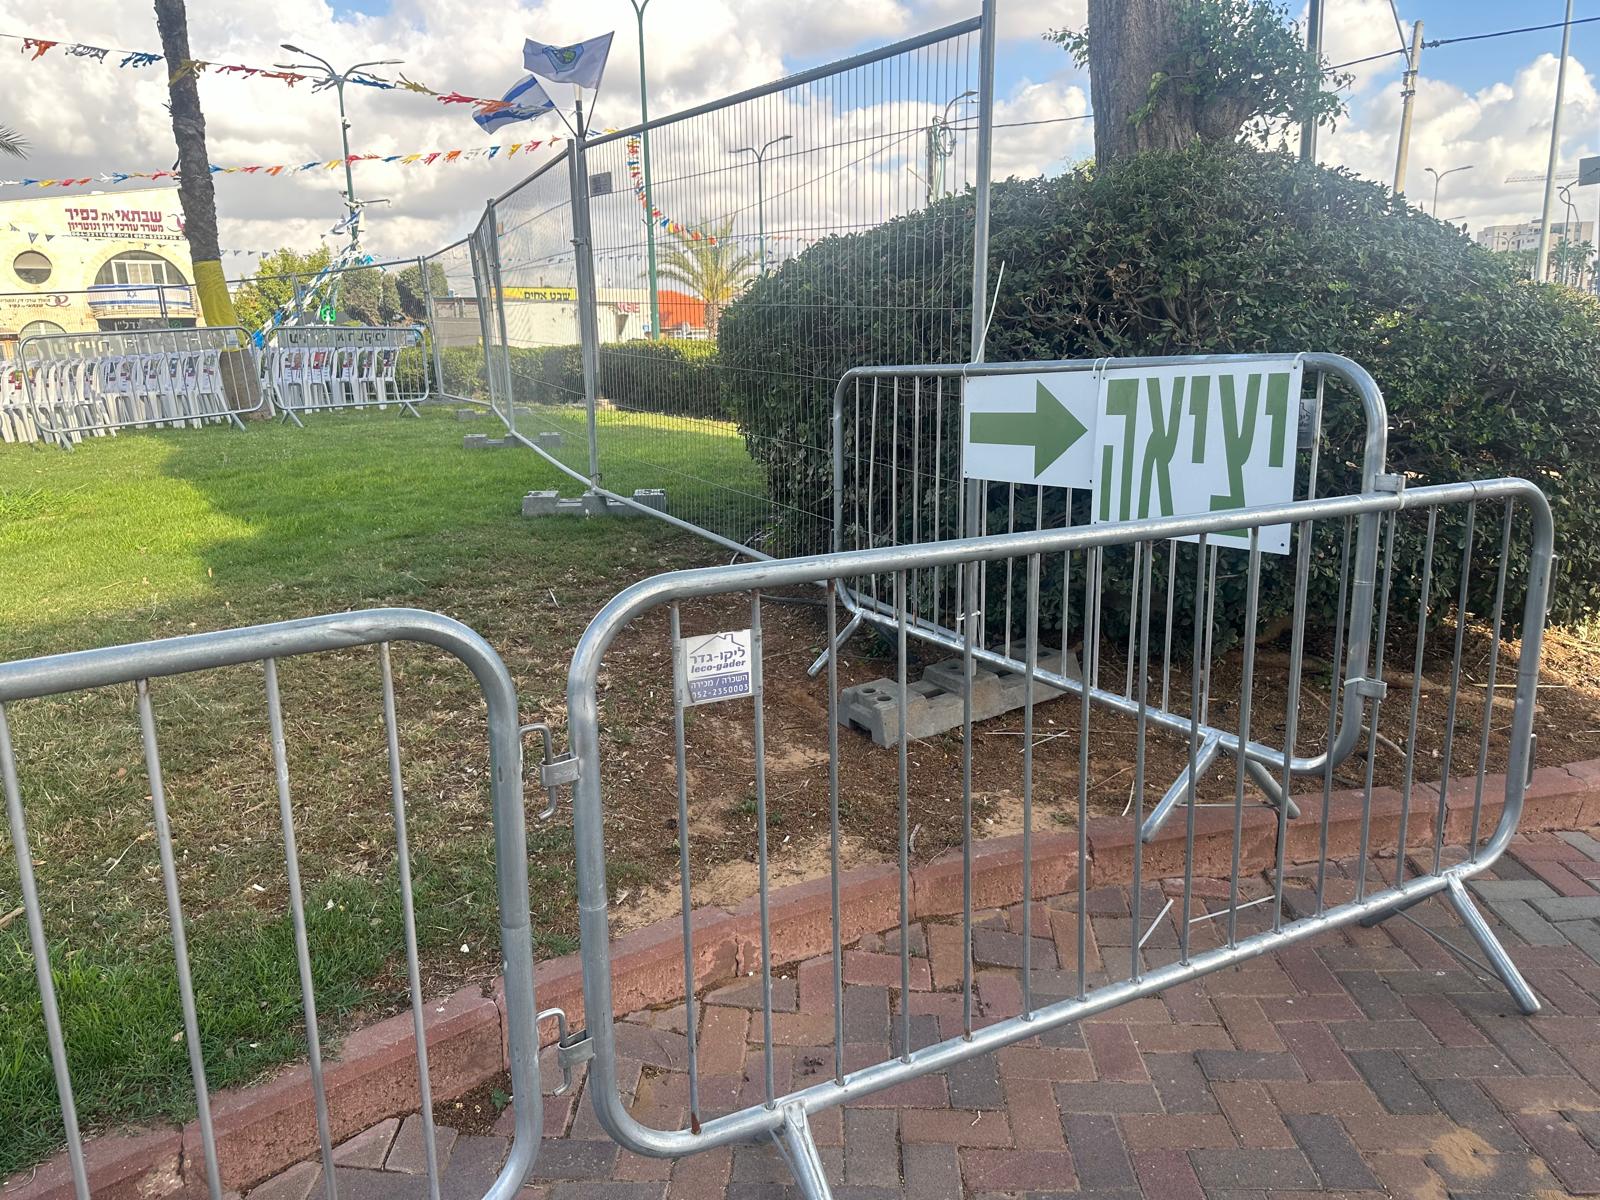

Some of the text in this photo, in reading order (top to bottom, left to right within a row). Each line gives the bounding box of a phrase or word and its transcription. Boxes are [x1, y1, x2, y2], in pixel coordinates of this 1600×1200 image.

[65, 208, 162, 222] שבתאי את כפיר
[102, 223, 115, 232] דין
[116, 223, 139, 232] עורכי
[140, 224, 164, 232] משרד
[524, 291, 570, 301] שבט אחים
[1099, 373, 1290, 538] יציאה
[689, 647, 745, 664] ליקו-גדר
[690, 679, 714, 689] מכירה
[722, 674, 748, 684] השכרה
